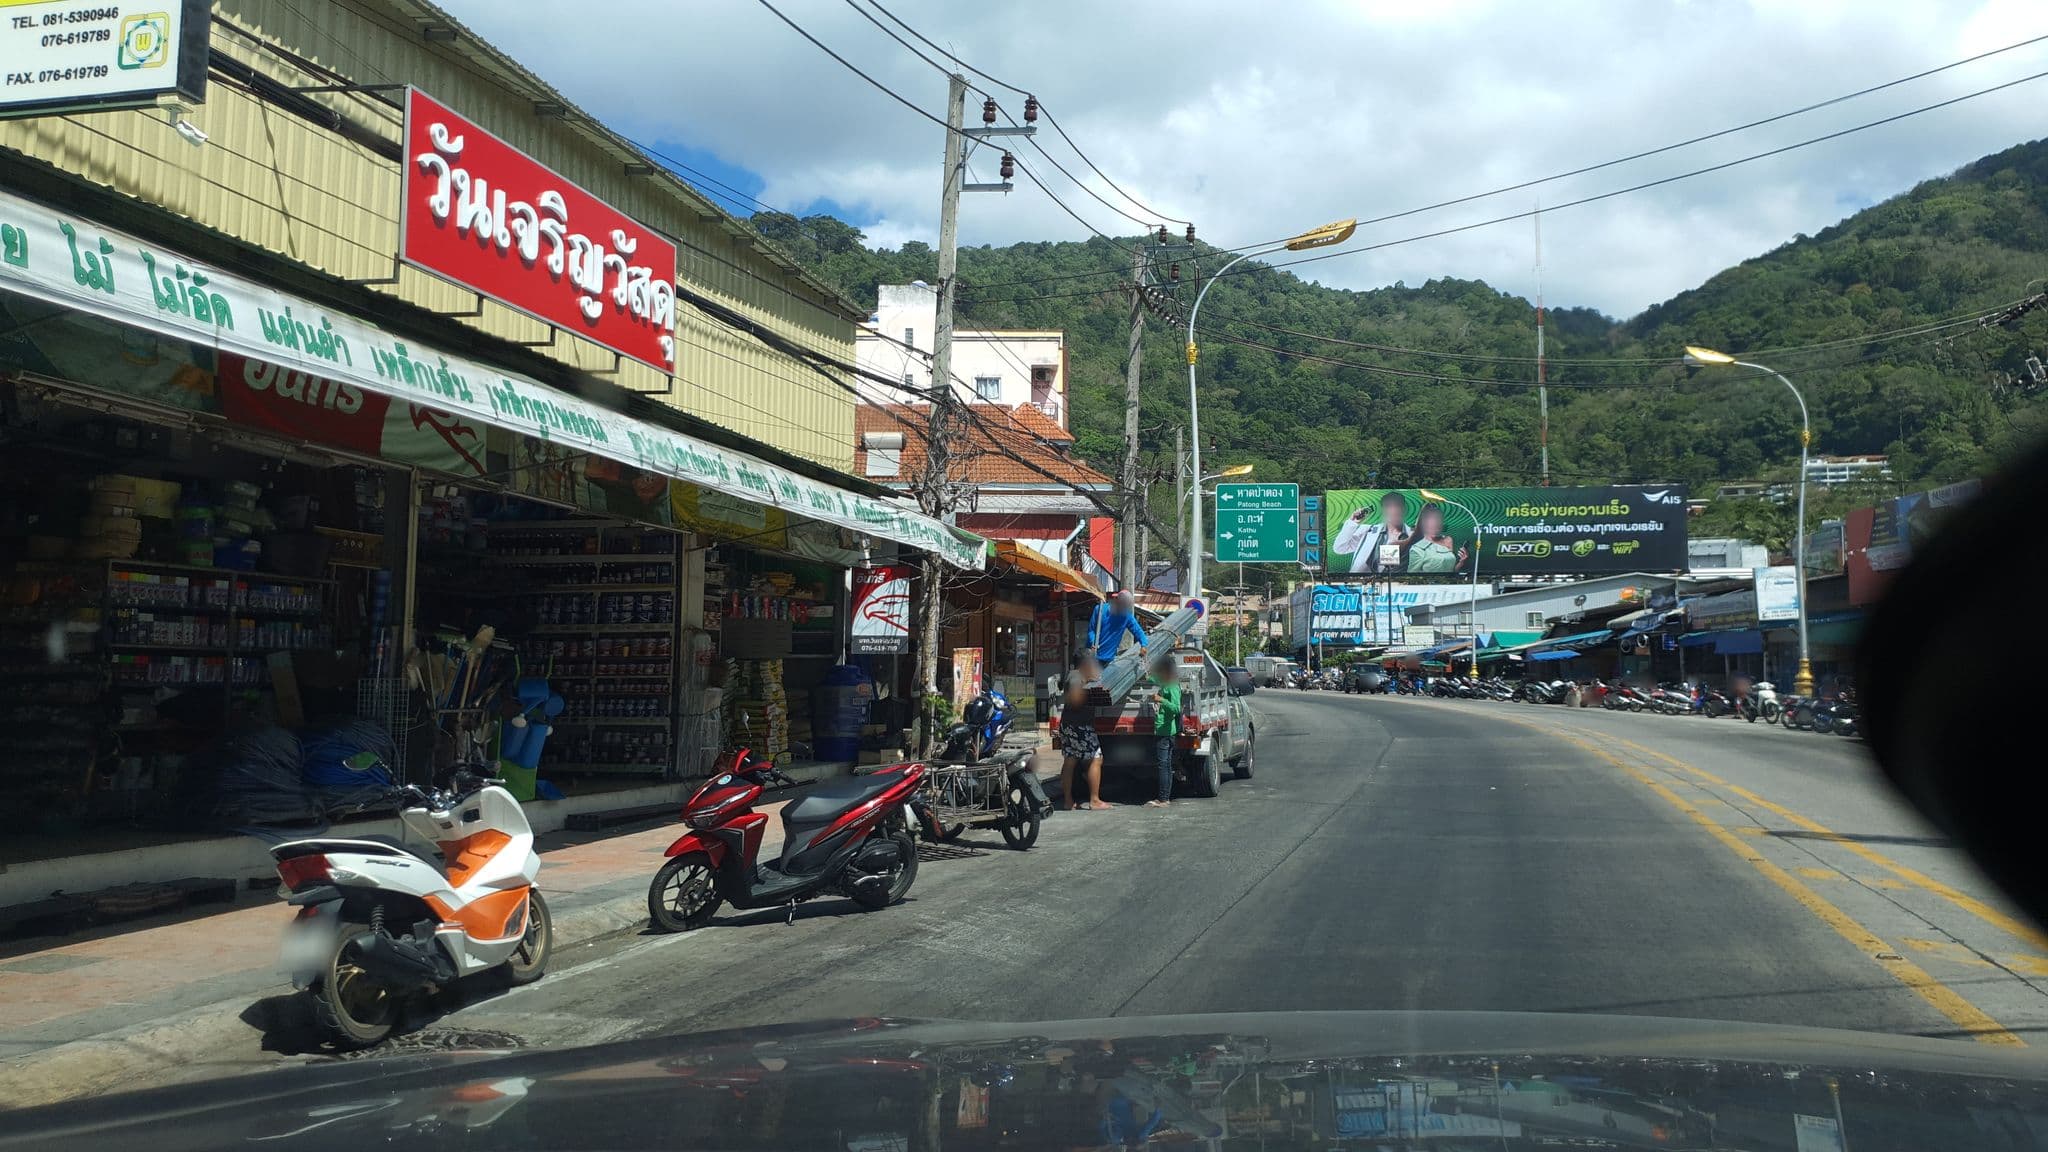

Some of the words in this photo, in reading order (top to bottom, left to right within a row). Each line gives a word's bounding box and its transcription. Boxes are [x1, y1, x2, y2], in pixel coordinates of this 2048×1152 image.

[11, 17, 39, 29] TEL.
[42, 7, 119, 26] 081-5390946
[41, 29, 111, 47] 076-619789
[6, 72, 36, 86] FAX.
[39, 65, 108, 83] 076-619789
[417, 122, 675, 362] วันเจริญวัสดุ
[58, 219, 116, 295] ไม้
[139, 248, 235, 331] ไม้อัด
[370, 342, 474, 404] เหล็กเส้น
[1237, 485, 1283, 498] หาดป่าตอง
[1290, 488, 1295, 498] 1
[1661, 495, 1682, 504] AIS
[1237, 501, 1260, 509] Patong
[1505, 499, 1631, 517] เครือข่ายความเร็ว
[1288, 514, 1295, 524] 4
[1473, 519, 1574, 537] เาใจทุกการเชื่อมต่อ
[1304, 497, 1320, 562] SIGN
[1285, 539, 1295, 548] 10
[1312, 593, 1360, 611] SIGN
[1312, 615, 1361, 629] MAKER
